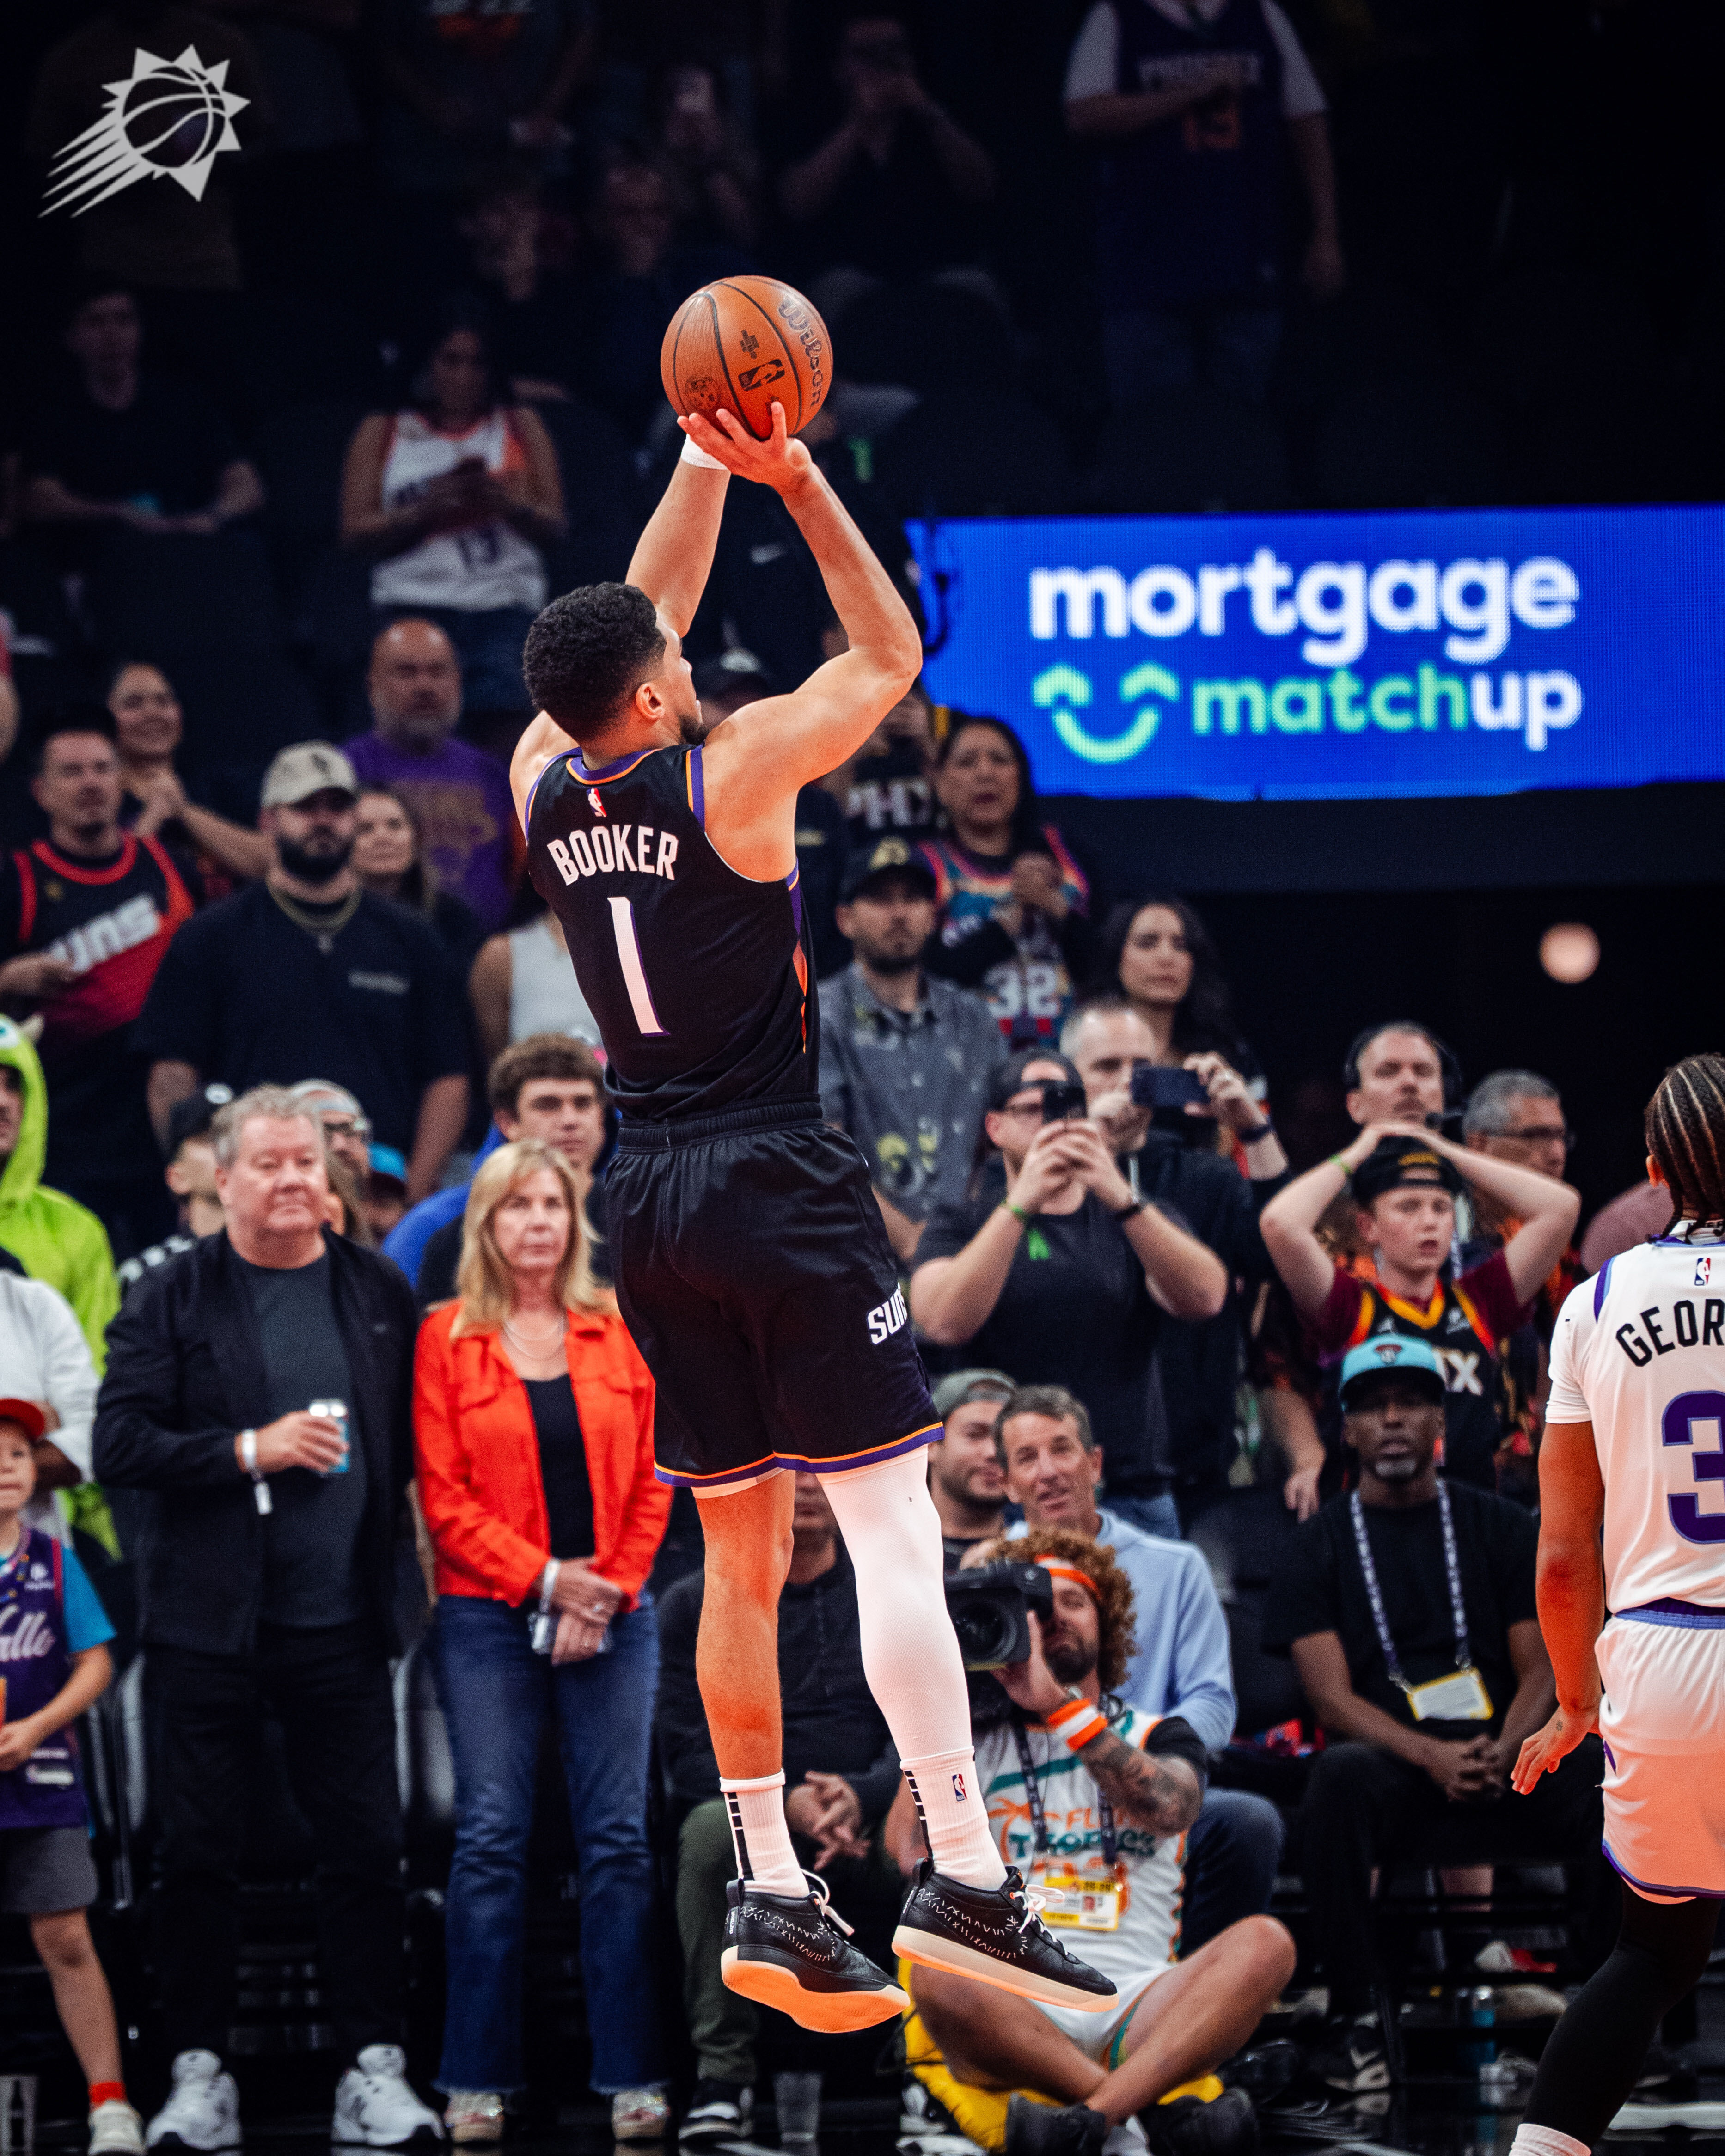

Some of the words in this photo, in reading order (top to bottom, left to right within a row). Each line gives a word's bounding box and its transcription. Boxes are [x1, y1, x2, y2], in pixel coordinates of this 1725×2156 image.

[1030, 546, 1580, 666] mortgage
[1191, 661, 1584, 752] matchup
[547, 824, 679, 886] BOOKER
[607, 897, 671, 1037] 1
[1616, 1299, 1725, 1367] GEOR
[1662, 1390, 1725, 1545] 3
